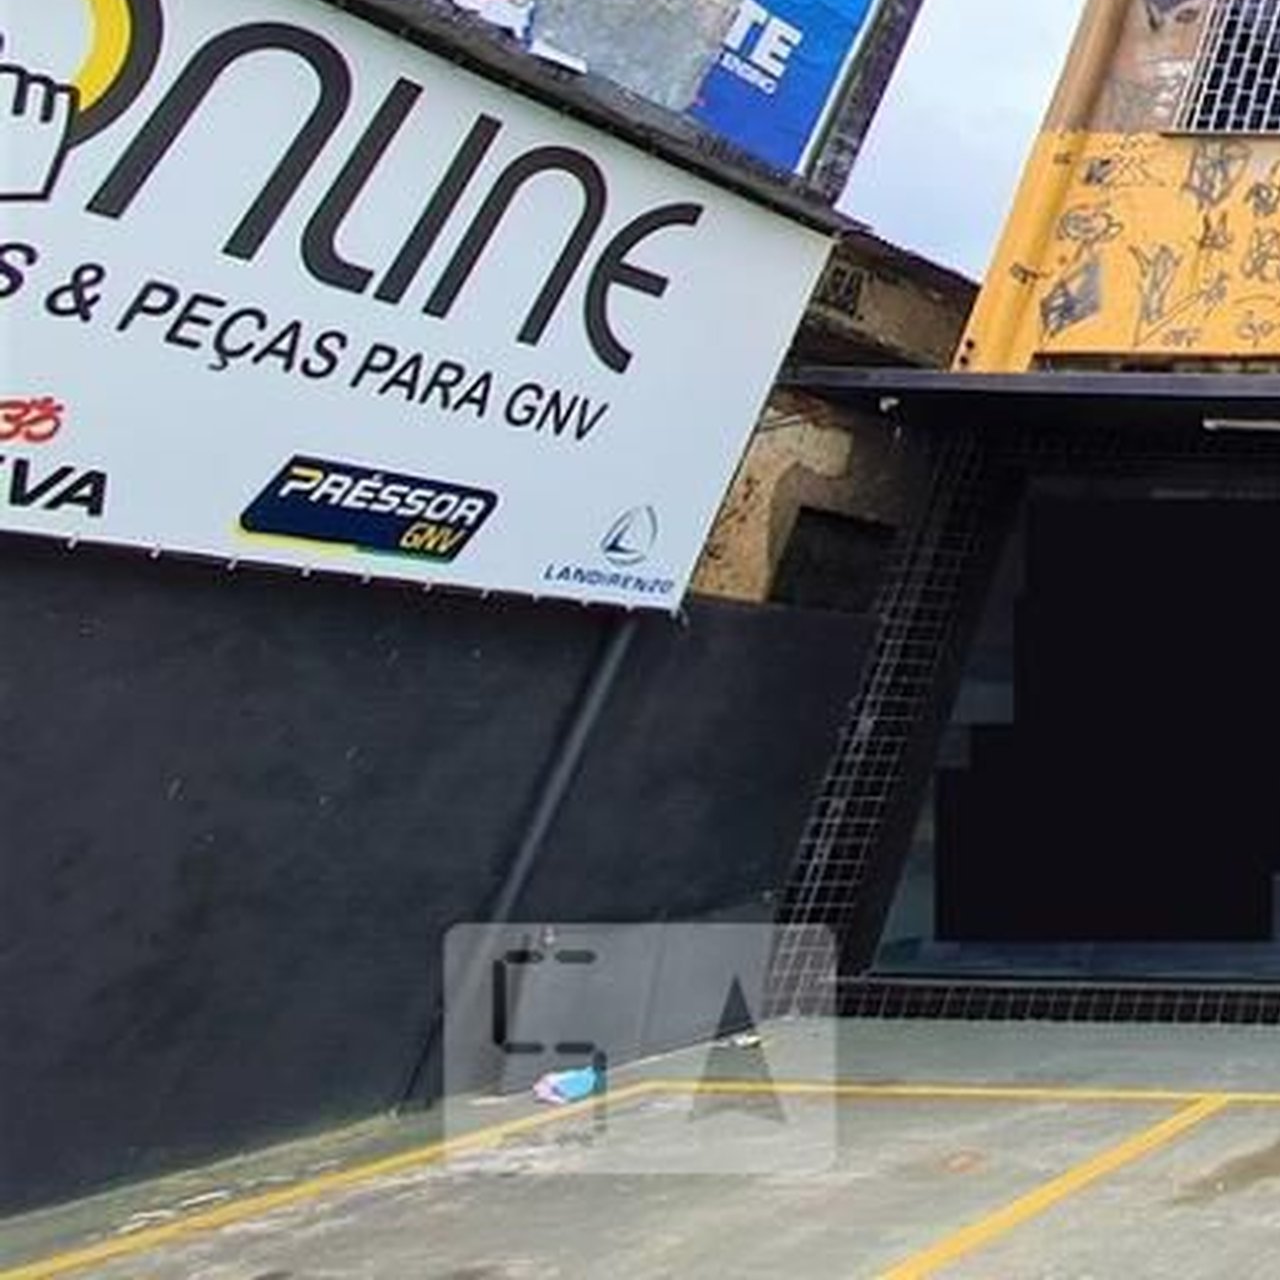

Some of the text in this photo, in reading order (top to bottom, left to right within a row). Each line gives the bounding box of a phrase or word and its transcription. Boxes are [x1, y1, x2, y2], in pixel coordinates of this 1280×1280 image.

[45, 263, 106, 321] &
[117, 280, 348, 378] PEÇAS
[350, 342, 501, 418] PARA
[503, 382, 608, 441] GNV
[0, 455, 107, 517] VA
[400, 522, 467, 554] GNV
